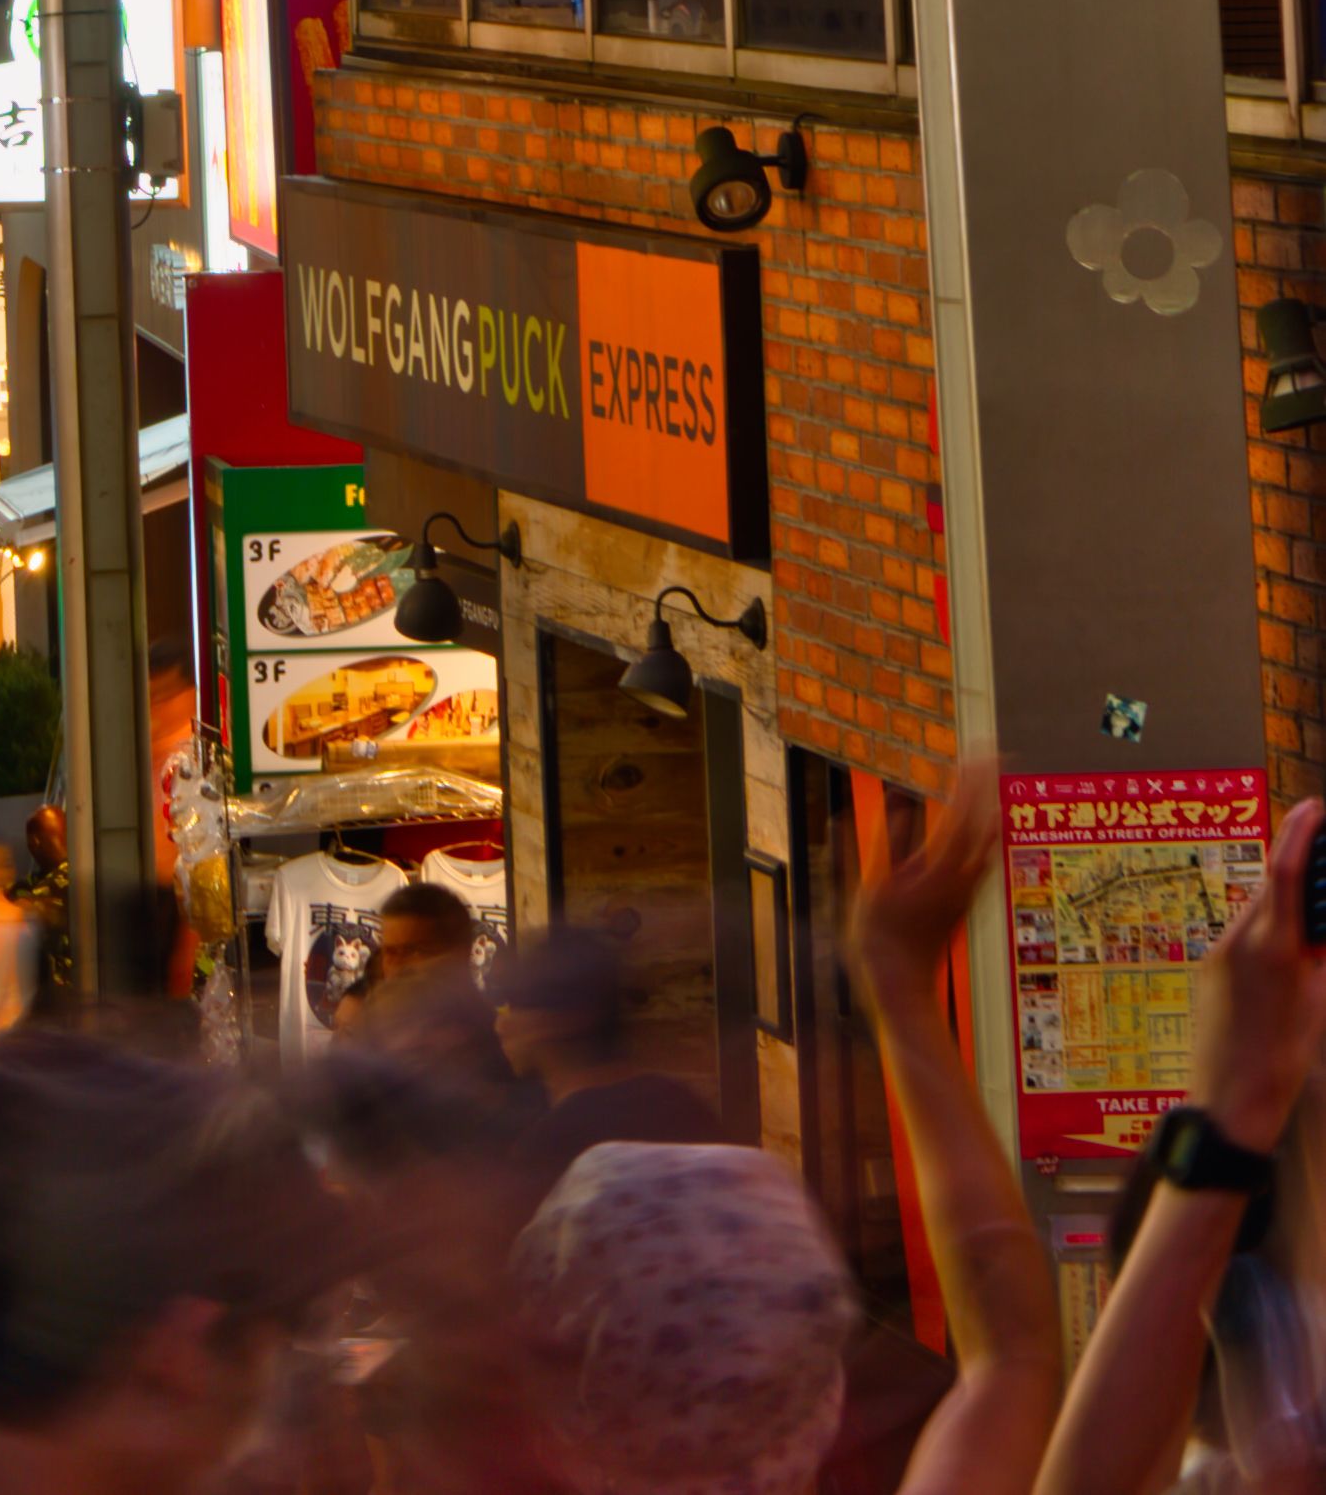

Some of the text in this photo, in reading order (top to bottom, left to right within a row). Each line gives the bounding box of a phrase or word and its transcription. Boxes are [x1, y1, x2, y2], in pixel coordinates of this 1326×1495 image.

[297, 263, 475, 395] WOLFGANG
[478, 303, 570, 419] PUCK
[589, 339, 717, 447] EXPRESS
[1009, 796, 1260, 830] 竹下通り公式マップ
[1010, 824, 1262, 843] TAKESHITA STREET OFFICIAL MAP
[1096, 1097, 1150, 1113] TAKE
